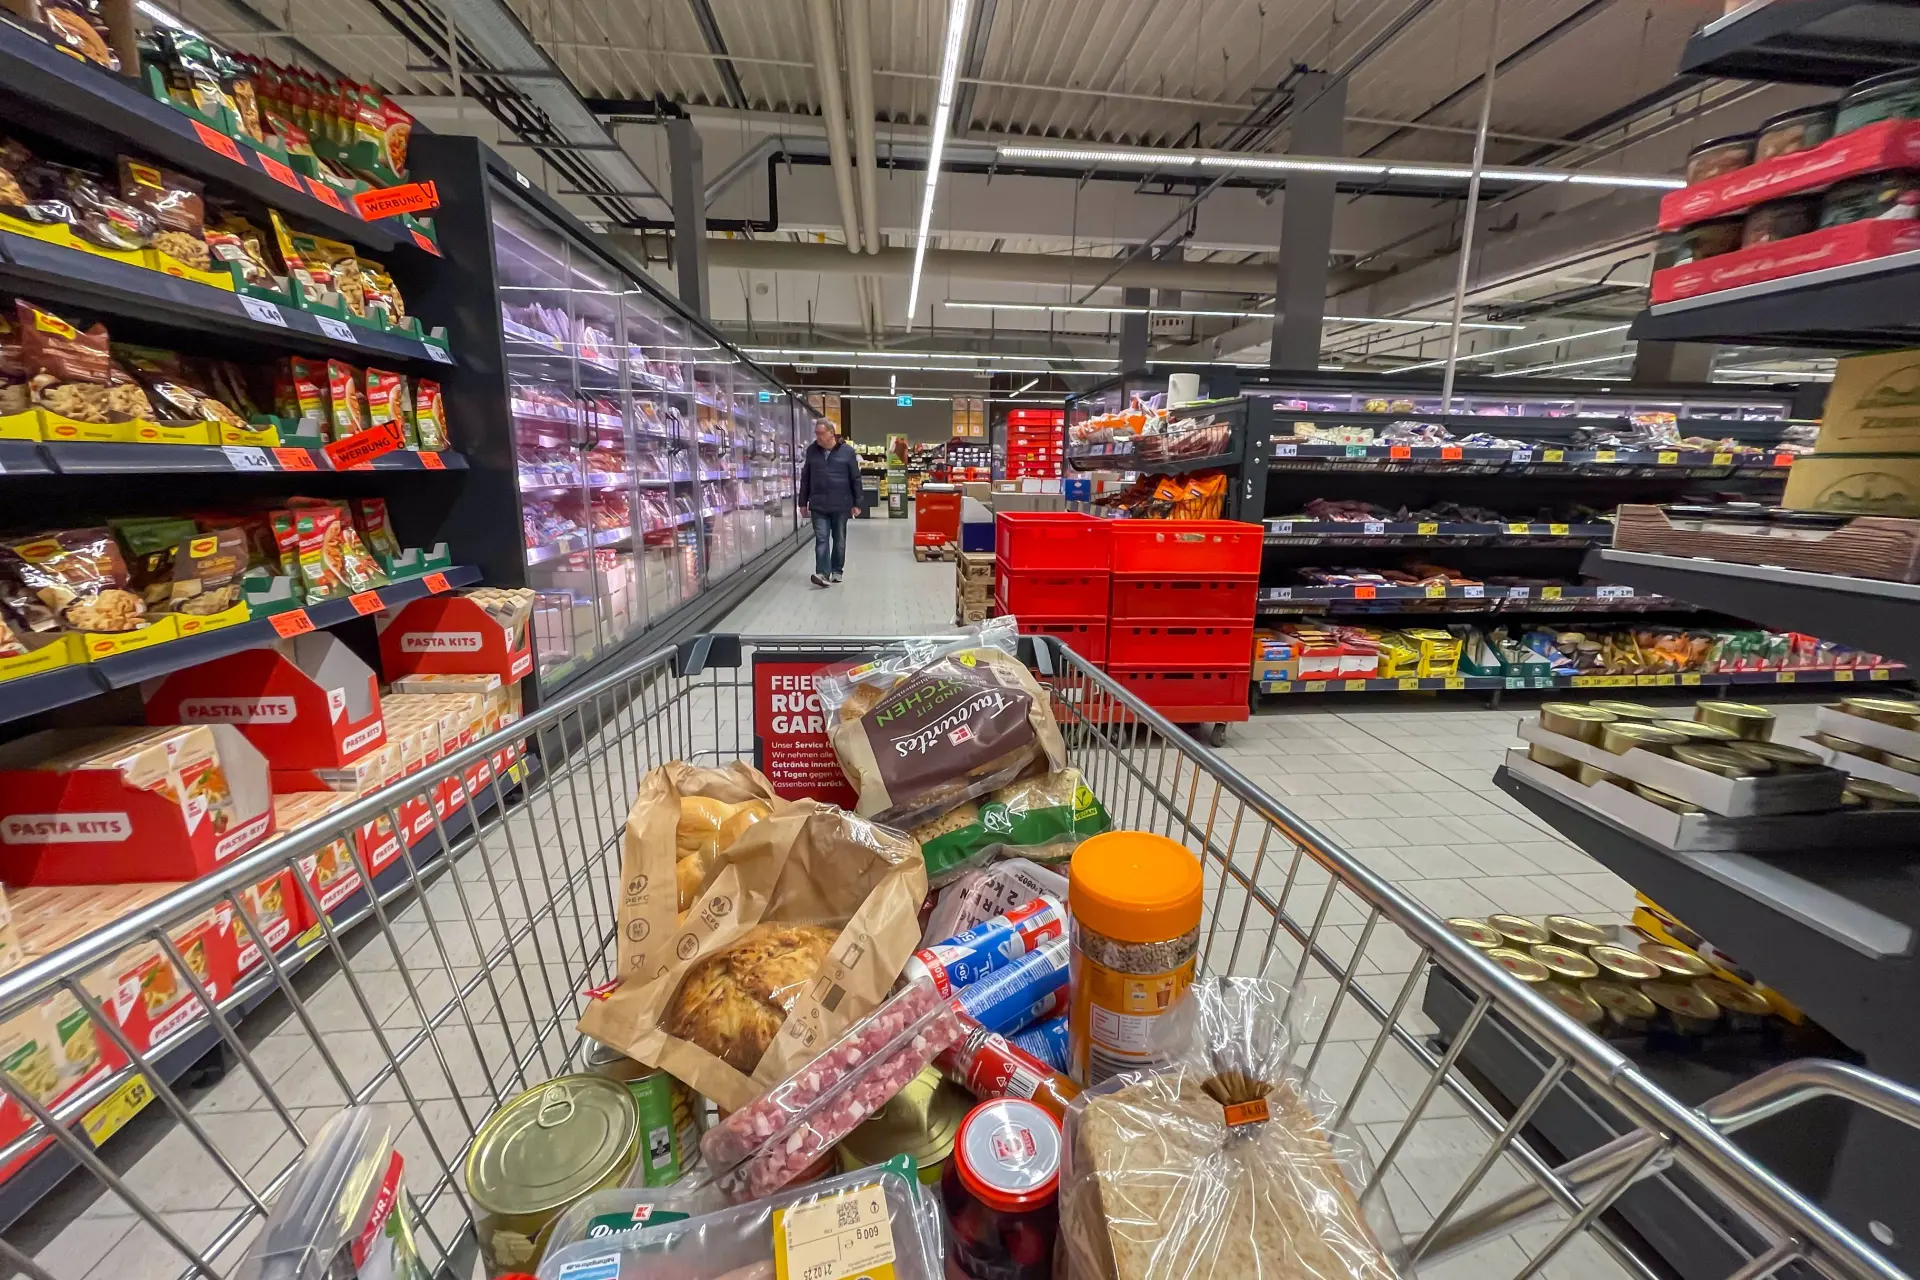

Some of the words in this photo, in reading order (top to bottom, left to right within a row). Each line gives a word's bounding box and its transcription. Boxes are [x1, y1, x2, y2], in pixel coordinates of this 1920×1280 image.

[366, 194, 423, 212] WERBUNG
[259, 307, 282, 322] 1.49
[335, 327, 355, 340] 1.49
[338, 436, 391, 463] WERBUNG
[244, 454, 268, 466] 1.29
[406, 638, 446, 647] PASTA
[450, 637, 477, 647] KITS
[771, 691, 823, 713] RÜC
[876, 677, 955, 728] TCHEN
[935, 684, 963, 706] UND
[187, 704, 243, 717] PASTA
[250, 703, 289, 716] KITS
[916, 702, 933, 718] FIT
[771, 715, 829, 734] GAR
[895, 692, 1014, 758] Favourites
[345, 734, 366, 750] PASTA
[366, 726, 380, 740] KITS
[795, 741, 824, 749] Service
[771, 760, 810, 768] Getränke
[771, 770, 781, 778] 14
[783, 770, 808, 779] Tagen
[1073, 806, 1098, 821] VEGAN
[9, 822, 73, 836] PASTA
[77, 820, 122, 834] KITS
[219, 831, 248, 853] PASTA
[375, 843, 394, 861] PASTA
[625, 894, 650, 905] PEFC
[1006, 890, 1019, 906] 2
[701, 908, 720, 931] PEFC
[267, 925, 287, 943] KITS
[154, 1010, 188, 1039] PASTA
[123, 1082, 148, 1109] 1.59
[371, 1185, 390, 1226] NR.1
[856, 1228, 862, 1240] g
[863, 1226, 879, 1240] 600
